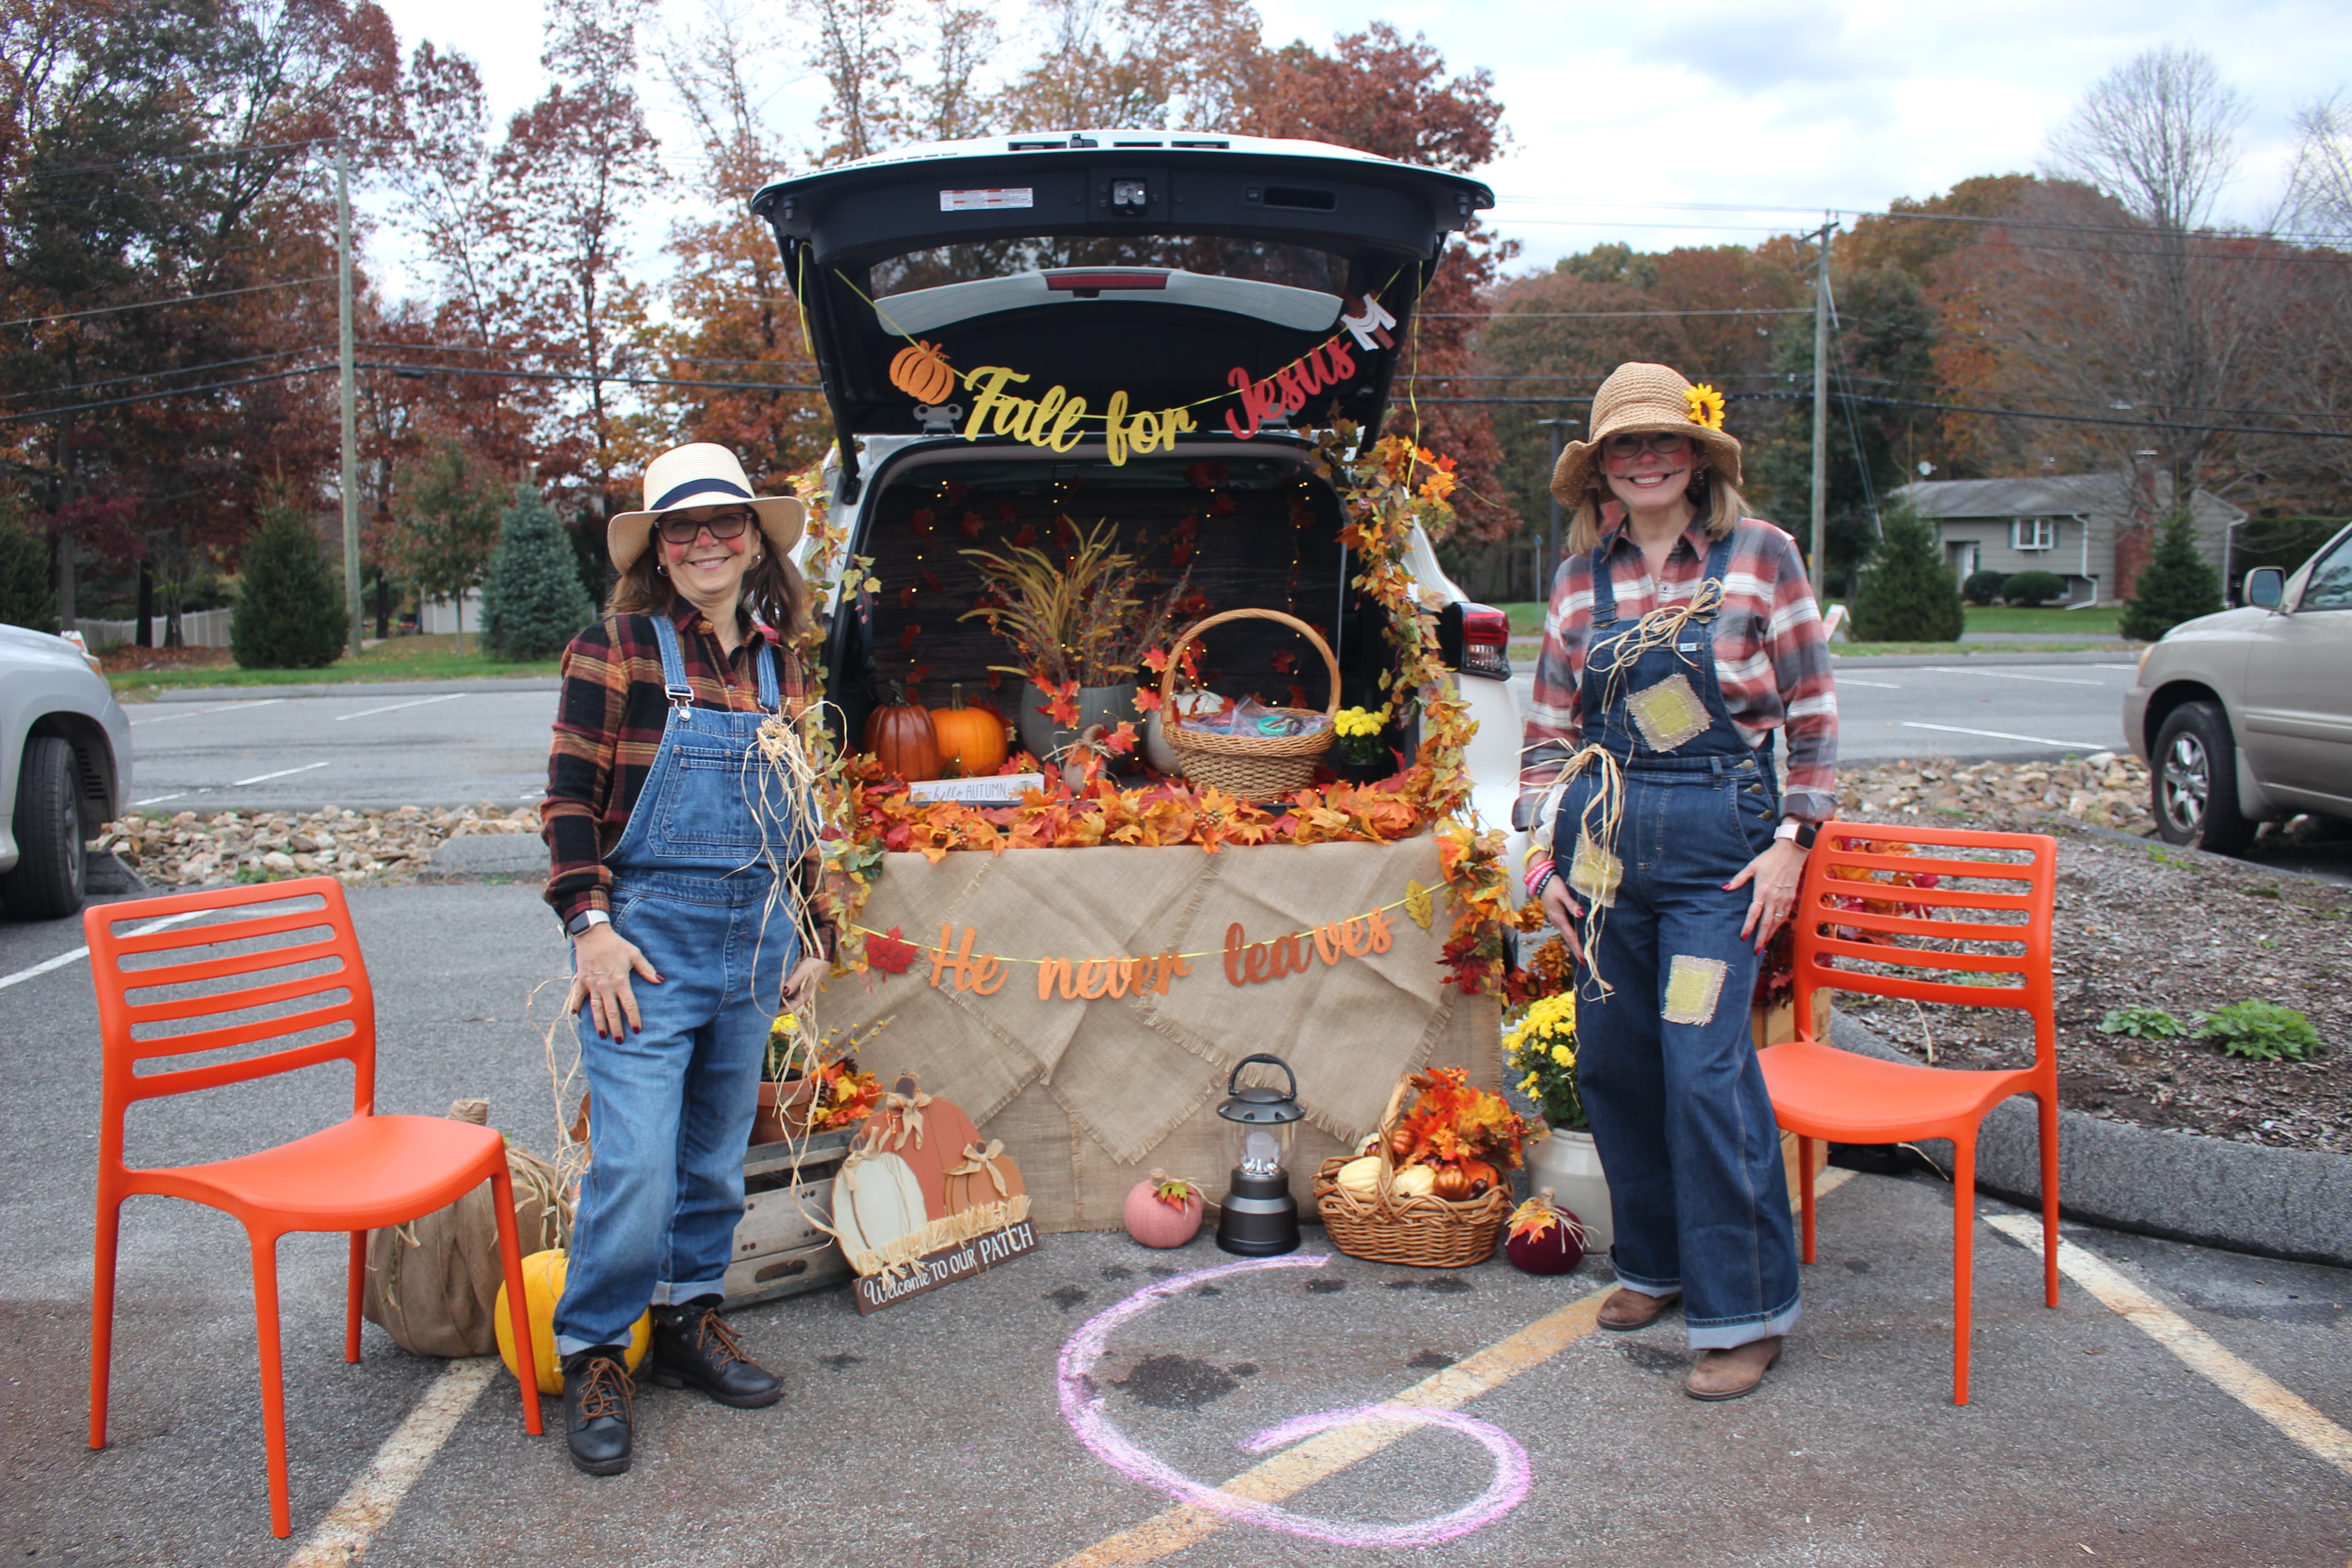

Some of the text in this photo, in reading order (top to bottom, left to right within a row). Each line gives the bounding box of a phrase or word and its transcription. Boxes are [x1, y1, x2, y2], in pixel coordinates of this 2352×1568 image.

[964, 337, 1356, 466] Fall for Jesus
[965, 782, 1007, 799] AUTUMN
[928, 907, 1395, 1000] He never leaves
[929, 1259, 948, 1281] TO
[950, 1248, 976, 1274] OUR
[979, 1223, 1034, 1264] PATCH
